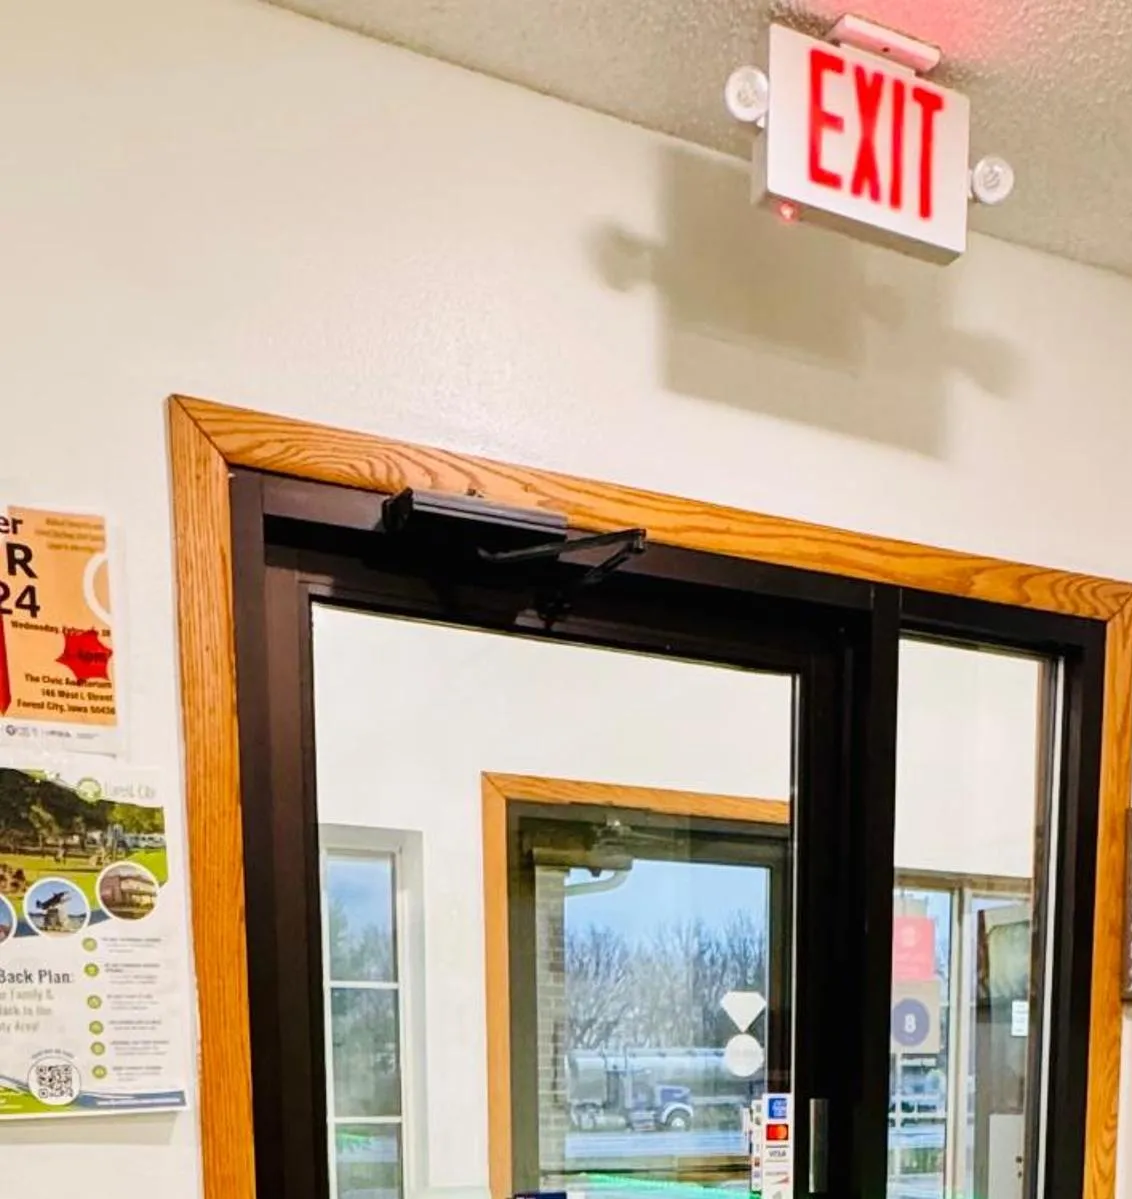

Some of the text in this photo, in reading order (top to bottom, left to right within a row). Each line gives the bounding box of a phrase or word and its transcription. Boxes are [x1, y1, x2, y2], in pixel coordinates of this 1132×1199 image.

[808, 48, 944, 220] EXIT
[25, 673, 40, 683] The
[57, 690, 79, 699] West
